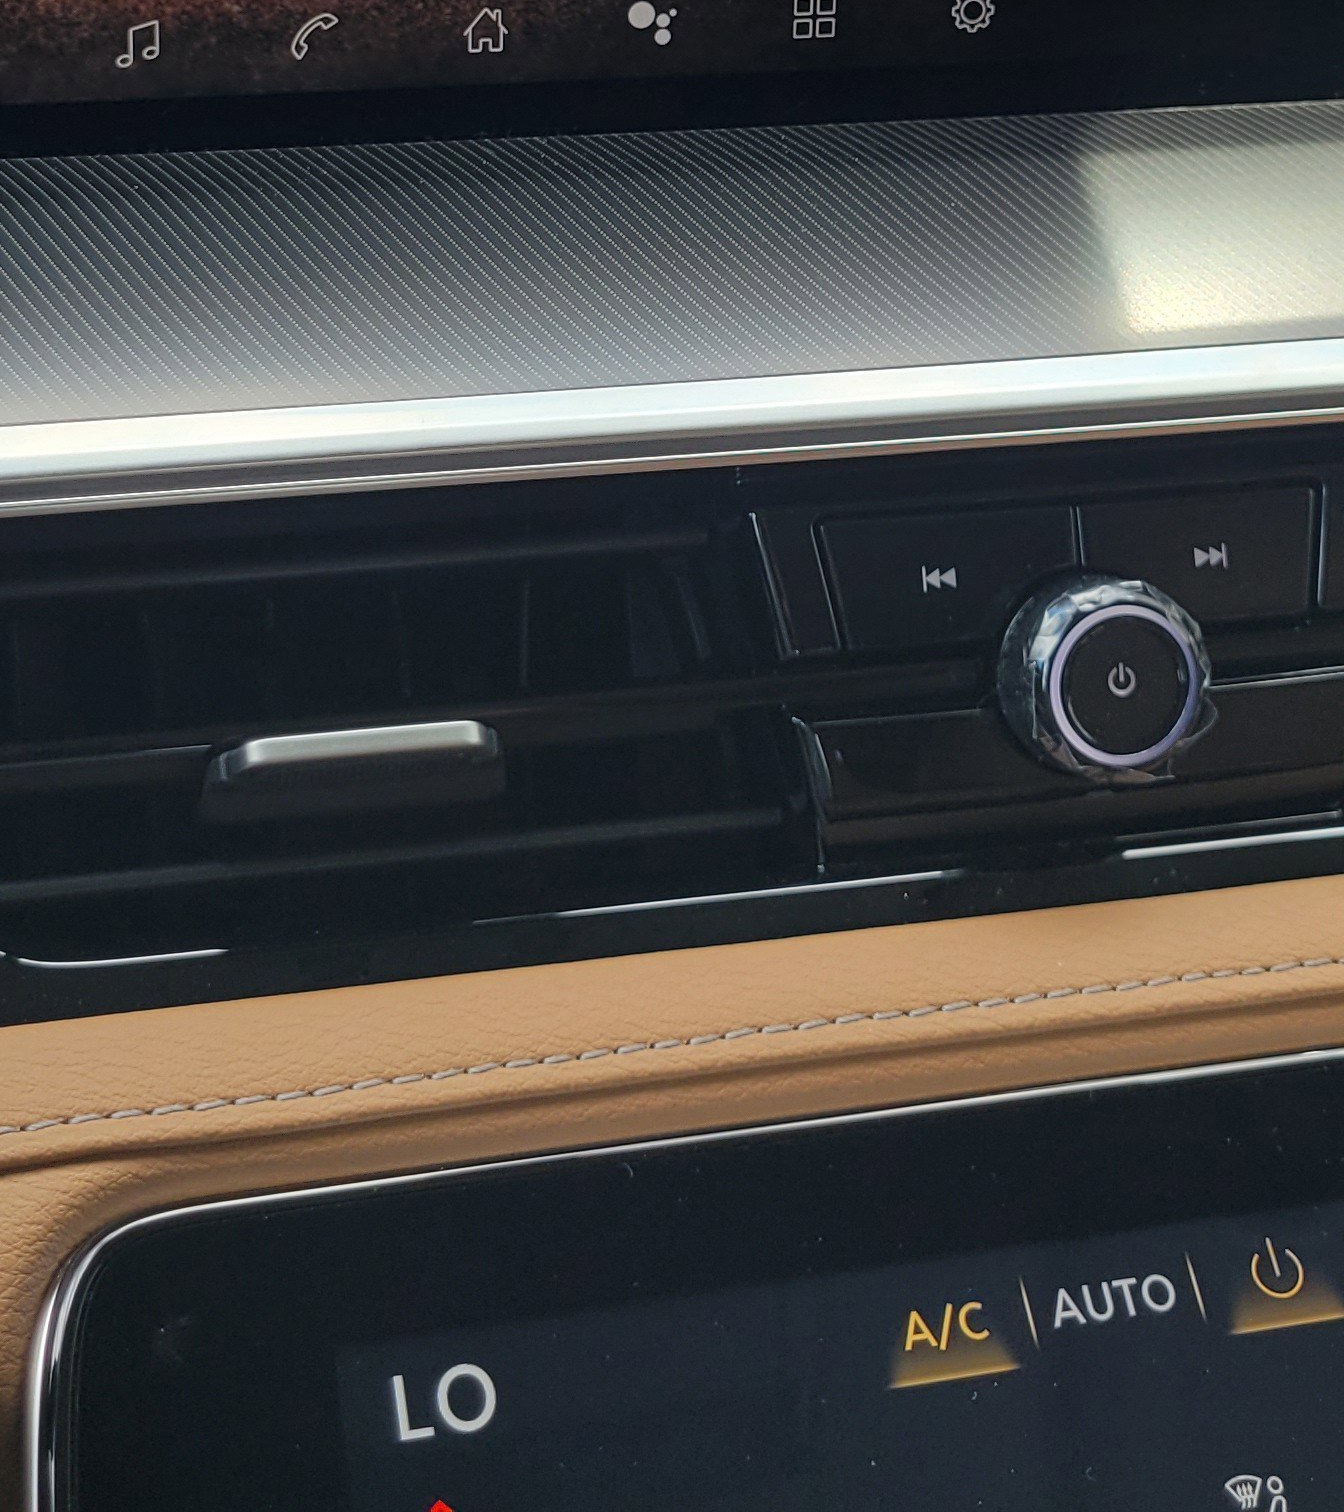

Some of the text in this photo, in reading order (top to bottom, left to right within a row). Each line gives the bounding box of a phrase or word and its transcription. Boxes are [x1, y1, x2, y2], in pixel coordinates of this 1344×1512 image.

[903, 1300, 991, 1352] A/C
[1052, 1273, 1177, 1330] AUTO
[391, 1361, 498, 1443] LO
